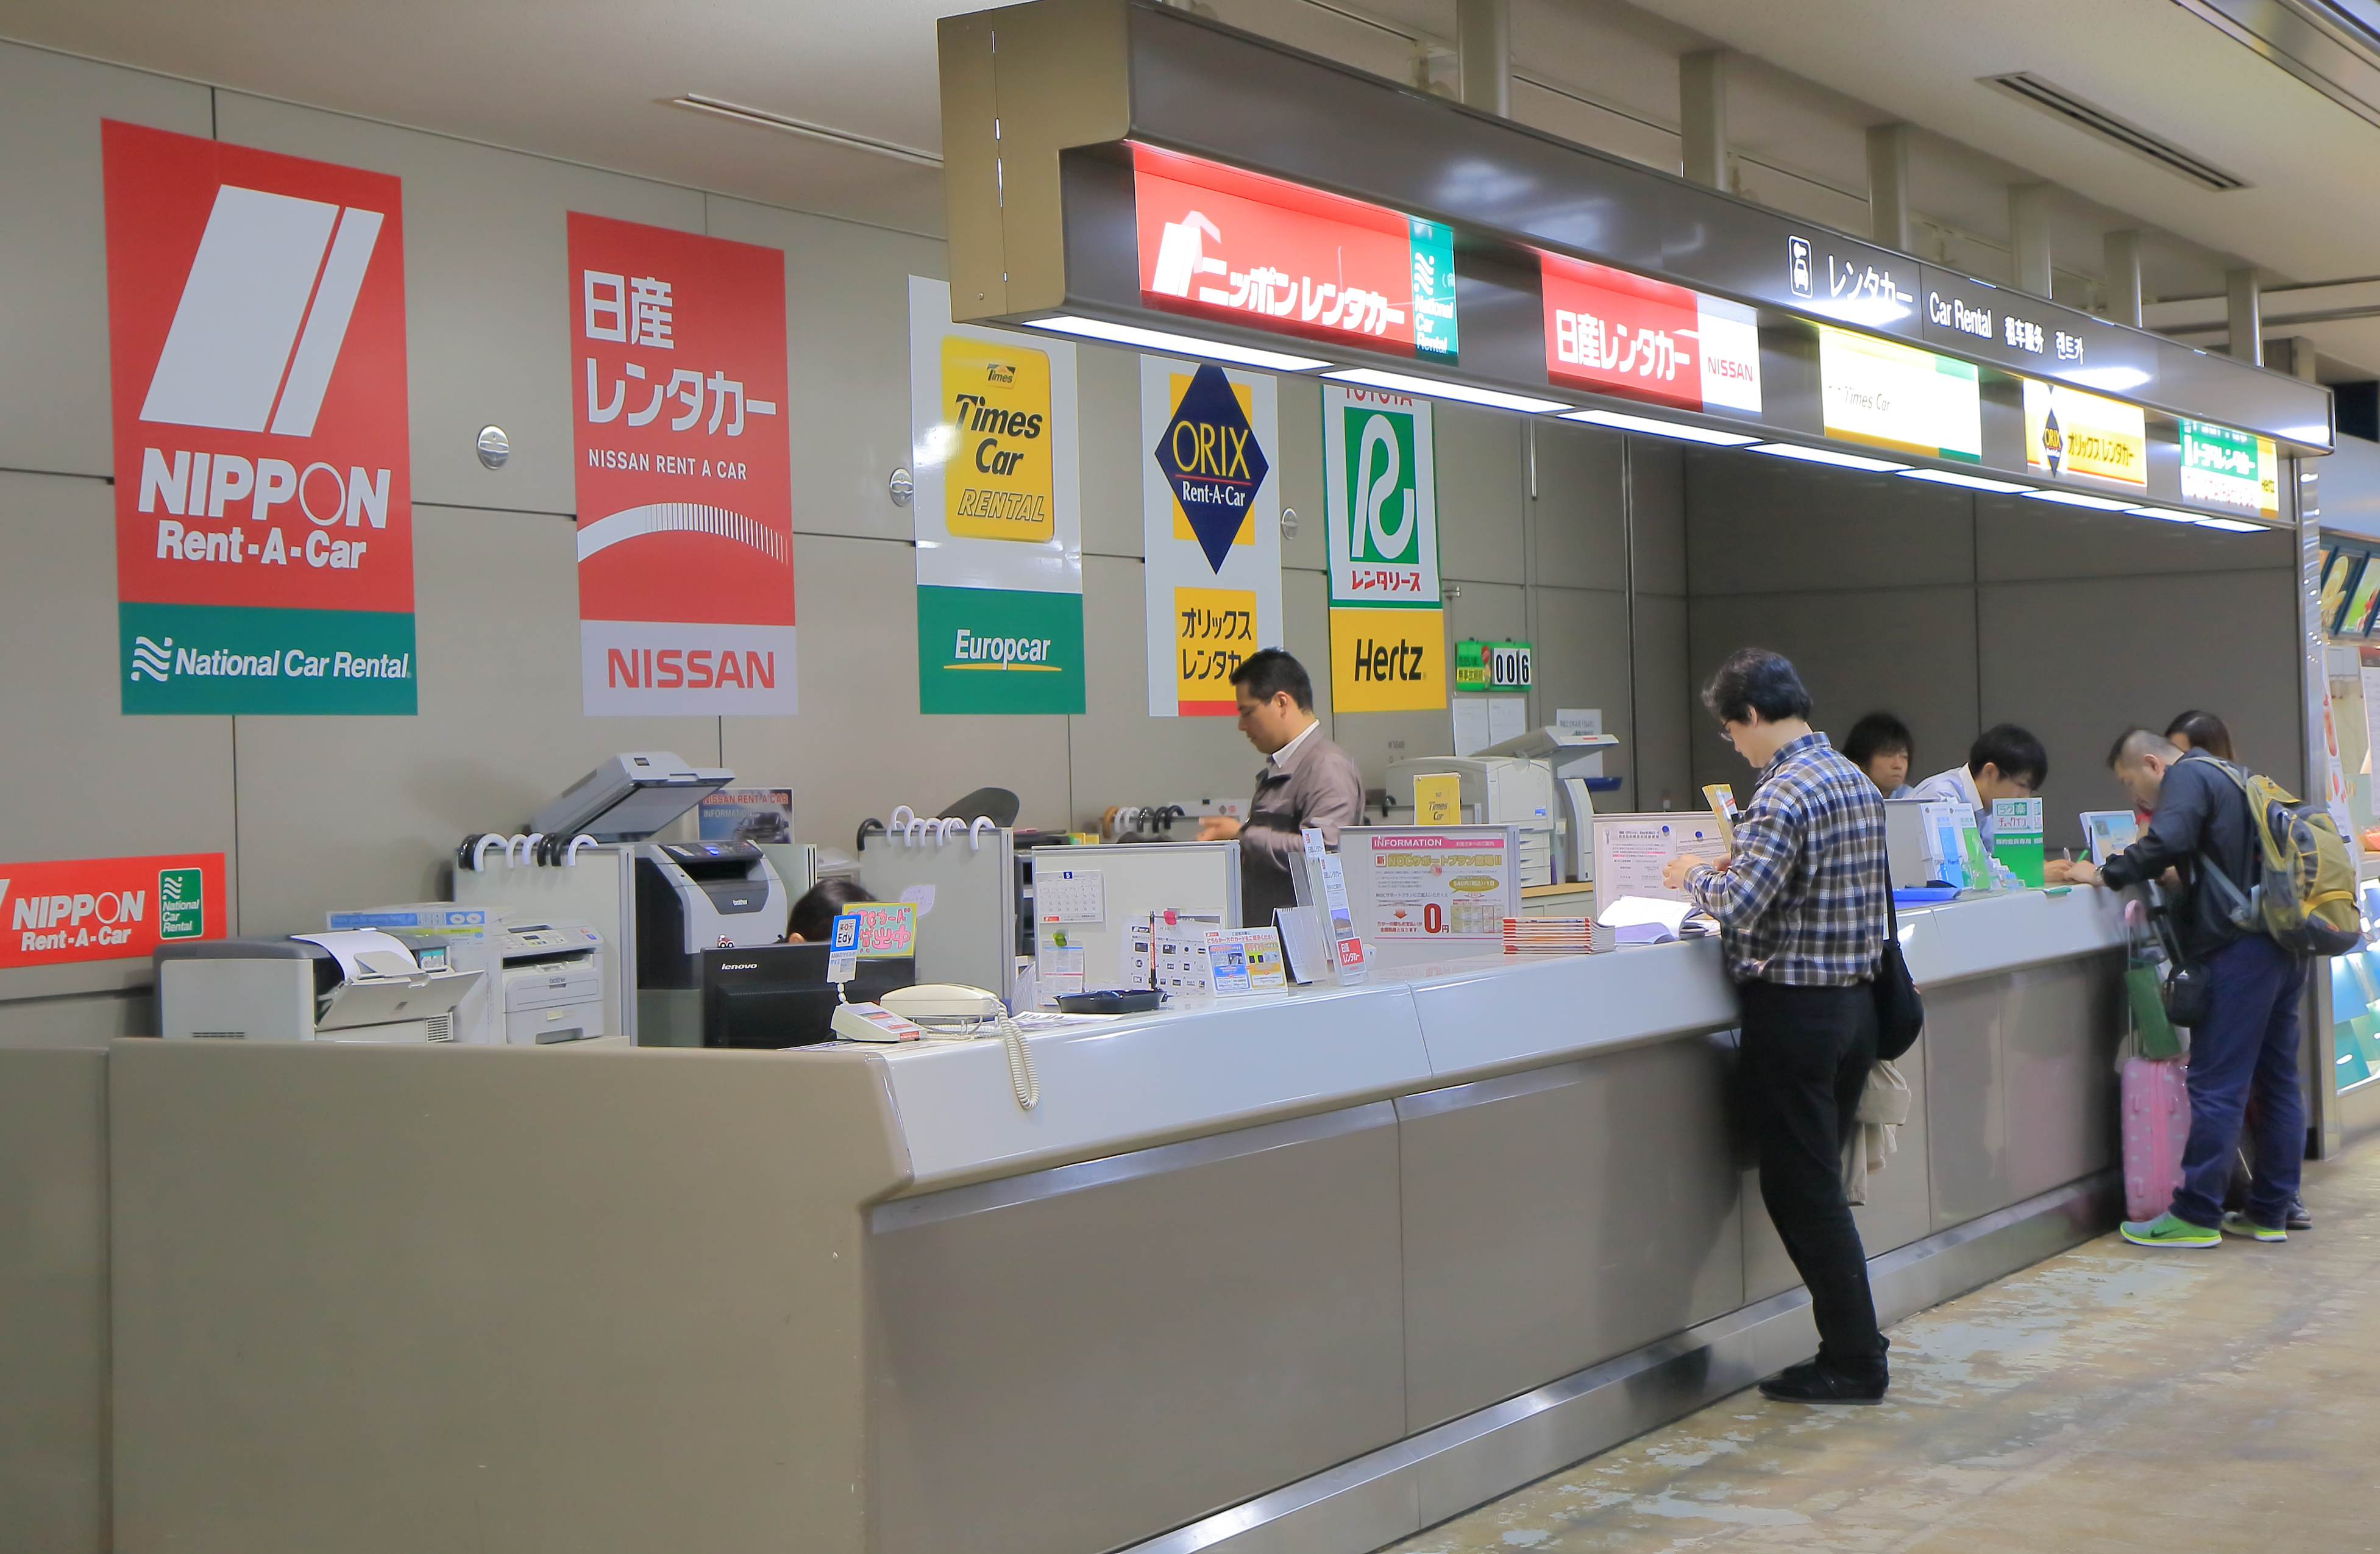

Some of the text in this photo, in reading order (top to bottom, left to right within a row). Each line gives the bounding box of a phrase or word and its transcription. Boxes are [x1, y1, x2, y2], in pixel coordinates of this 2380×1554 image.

[584, 269, 674, 349] 日産
[1199, 256, 1405, 336] ニッポンレンタカー
[1415, 294, 1454, 319] National
[1415, 312, 1435, 333] Car
[1929, 291, 1993, 339] Car Rental
[1416, 331, 1448, 354] Rental
[1555, 308, 1691, 382] 日産レンタカー
[2055, 330, 2084, 365] 렌트카
[986, 363, 1017, 383] Times
[1707, 356, 1753, 382] NISSAN
[586, 357, 777, 437] レンタカー
[1844, 386, 1891, 412] Times Car
[955, 393, 1043, 439] Times
[1172, 420, 1251, 479] ORIX
[2044, 427, 2061, 447] ORIX
[589, 448, 747, 480] NISSAN RENT A CAR
[975, 438, 1025, 476] Car
[138, 447, 392, 529] NIPPON
[1182, 480, 1246, 507] Rent-A-Car
[957, 488, 1045, 522] RENTAL
[157, 519, 367, 569] Rent-A-Car
[1351, 570, 1421, 592] レンタリース
[1181, 607, 1252, 641] オリックス
[175, 648, 408, 679] National Car Rental
[954, 629, 1051, 671] Europcar
[1182, 649, 1243, 680] レンタカ
[1354, 638, 1424, 682] Hertz
[608, 648, 775, 689] NISSAN
[1496, 654, 1530, 683] 006
[703, 794, 789, 804] NISSAN RENT A CAR
[703, 809, 753, 818] INFORMATION
[1429, 801, 1448, 811] Times
[1433, 811, 1444, 821] Car
[12, 890, 144, 930] NIPPON
[163, 899, 200, 911] National
[163, 911, 180, 922] Car
[848, 907, 911, 926] TCカード
[21, 925, 132, 951] Rent-A-Car
[163, 921, 193, 933] Rental
[837, 933, 853, 944] Edy
